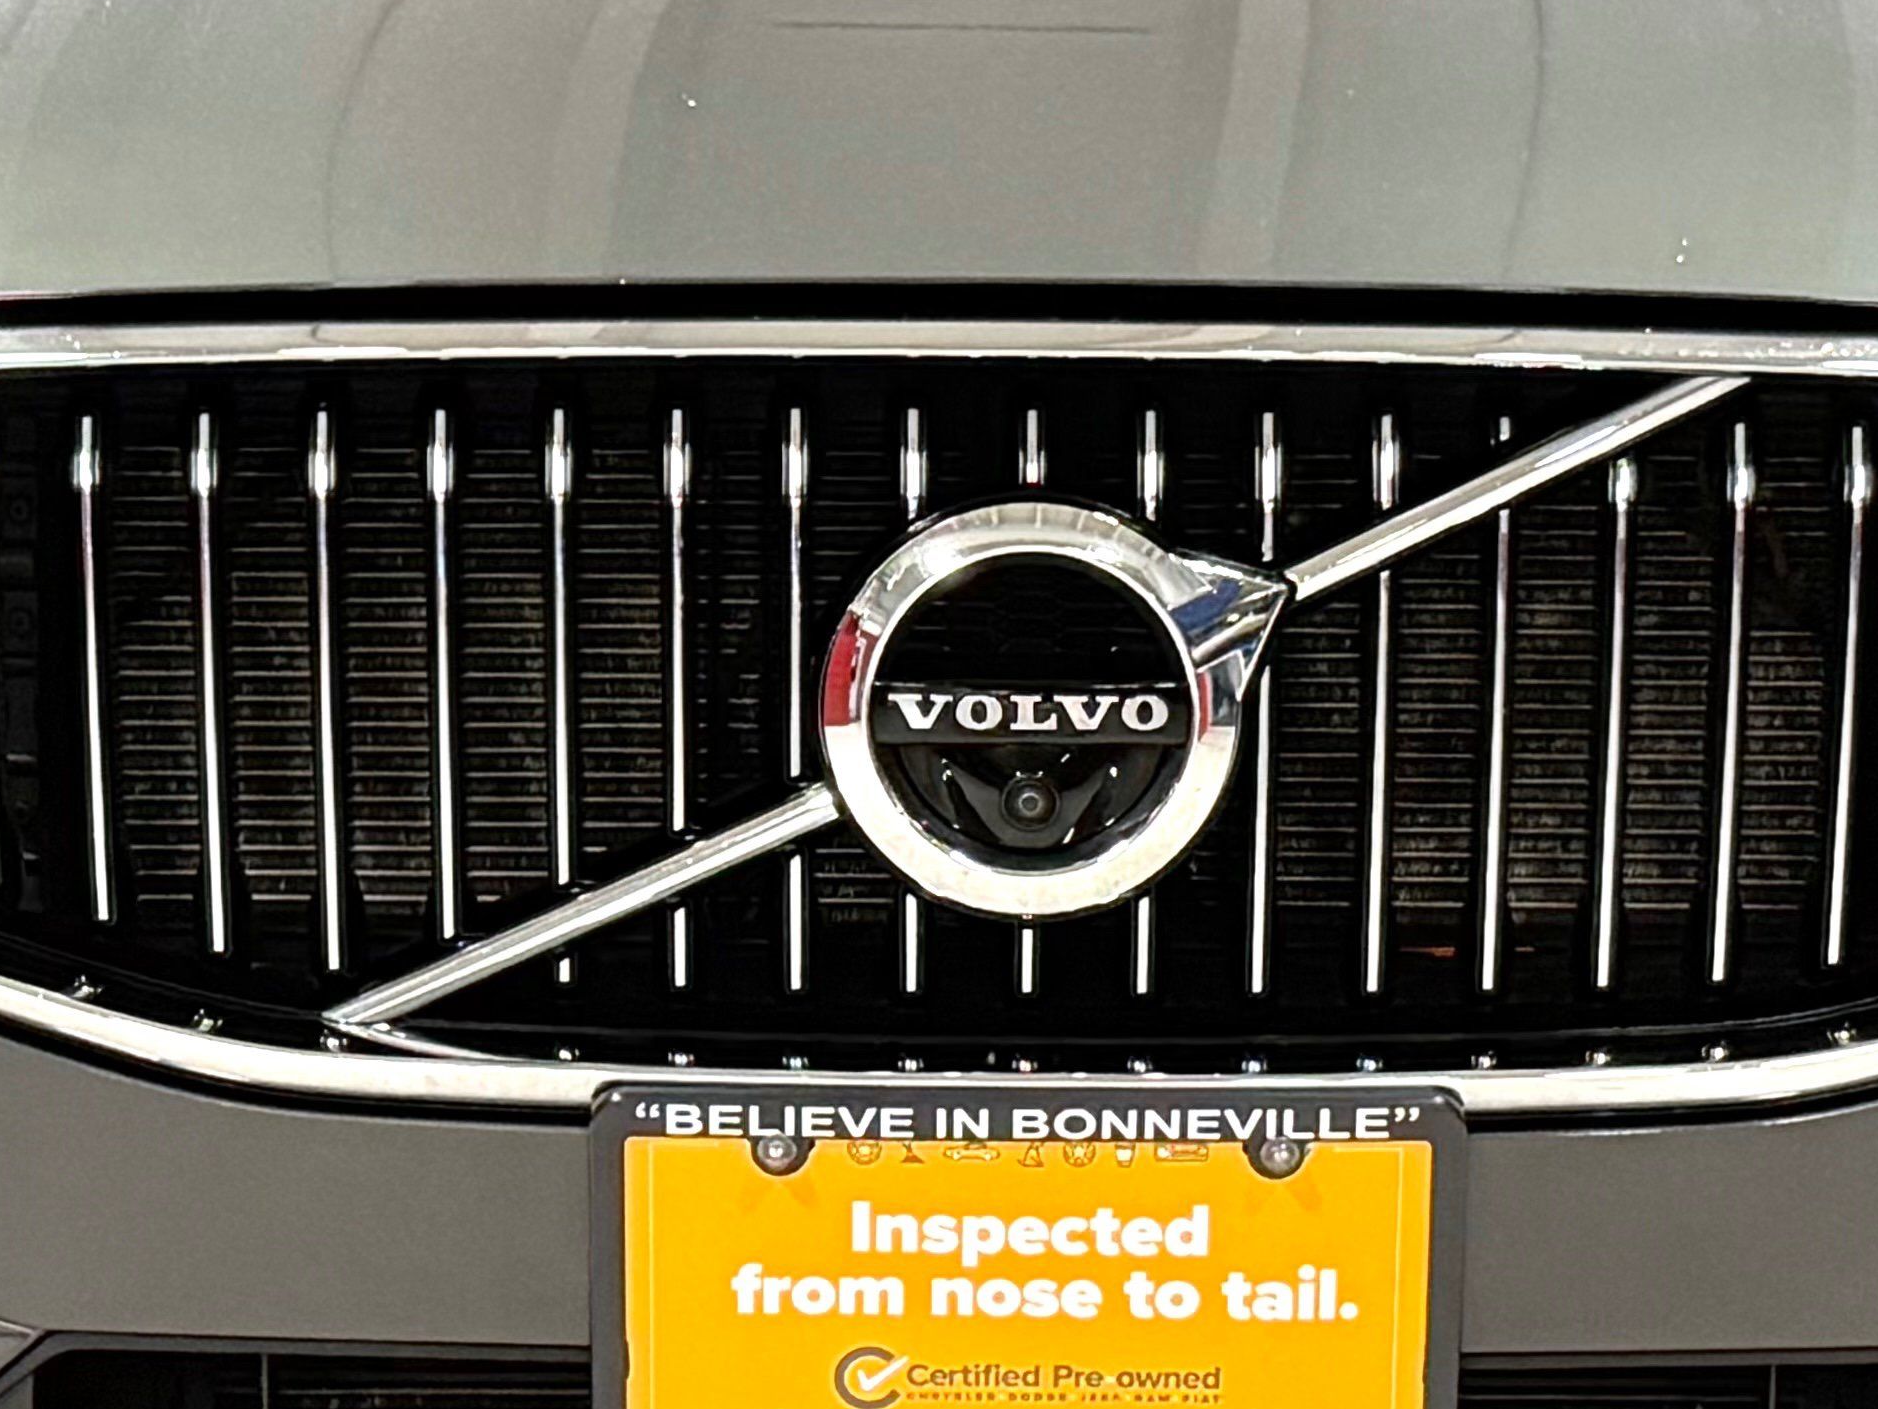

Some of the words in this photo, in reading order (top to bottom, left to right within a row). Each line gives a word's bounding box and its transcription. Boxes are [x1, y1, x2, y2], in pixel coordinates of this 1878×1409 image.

[887, 693, 1170, 732] VOLVO
[935, 1106, 990, 1140] IN
[850, 1199, 1211, 1268] Inspected
[730, 1262, 905, 1316] from
[929, 1274, 1103, 1318] nose
[1123, 1270, 1202, 1320] to
[1221, 1263, 1360, 1322] tail.
[906, 1363, 1041, 1387] Certified
